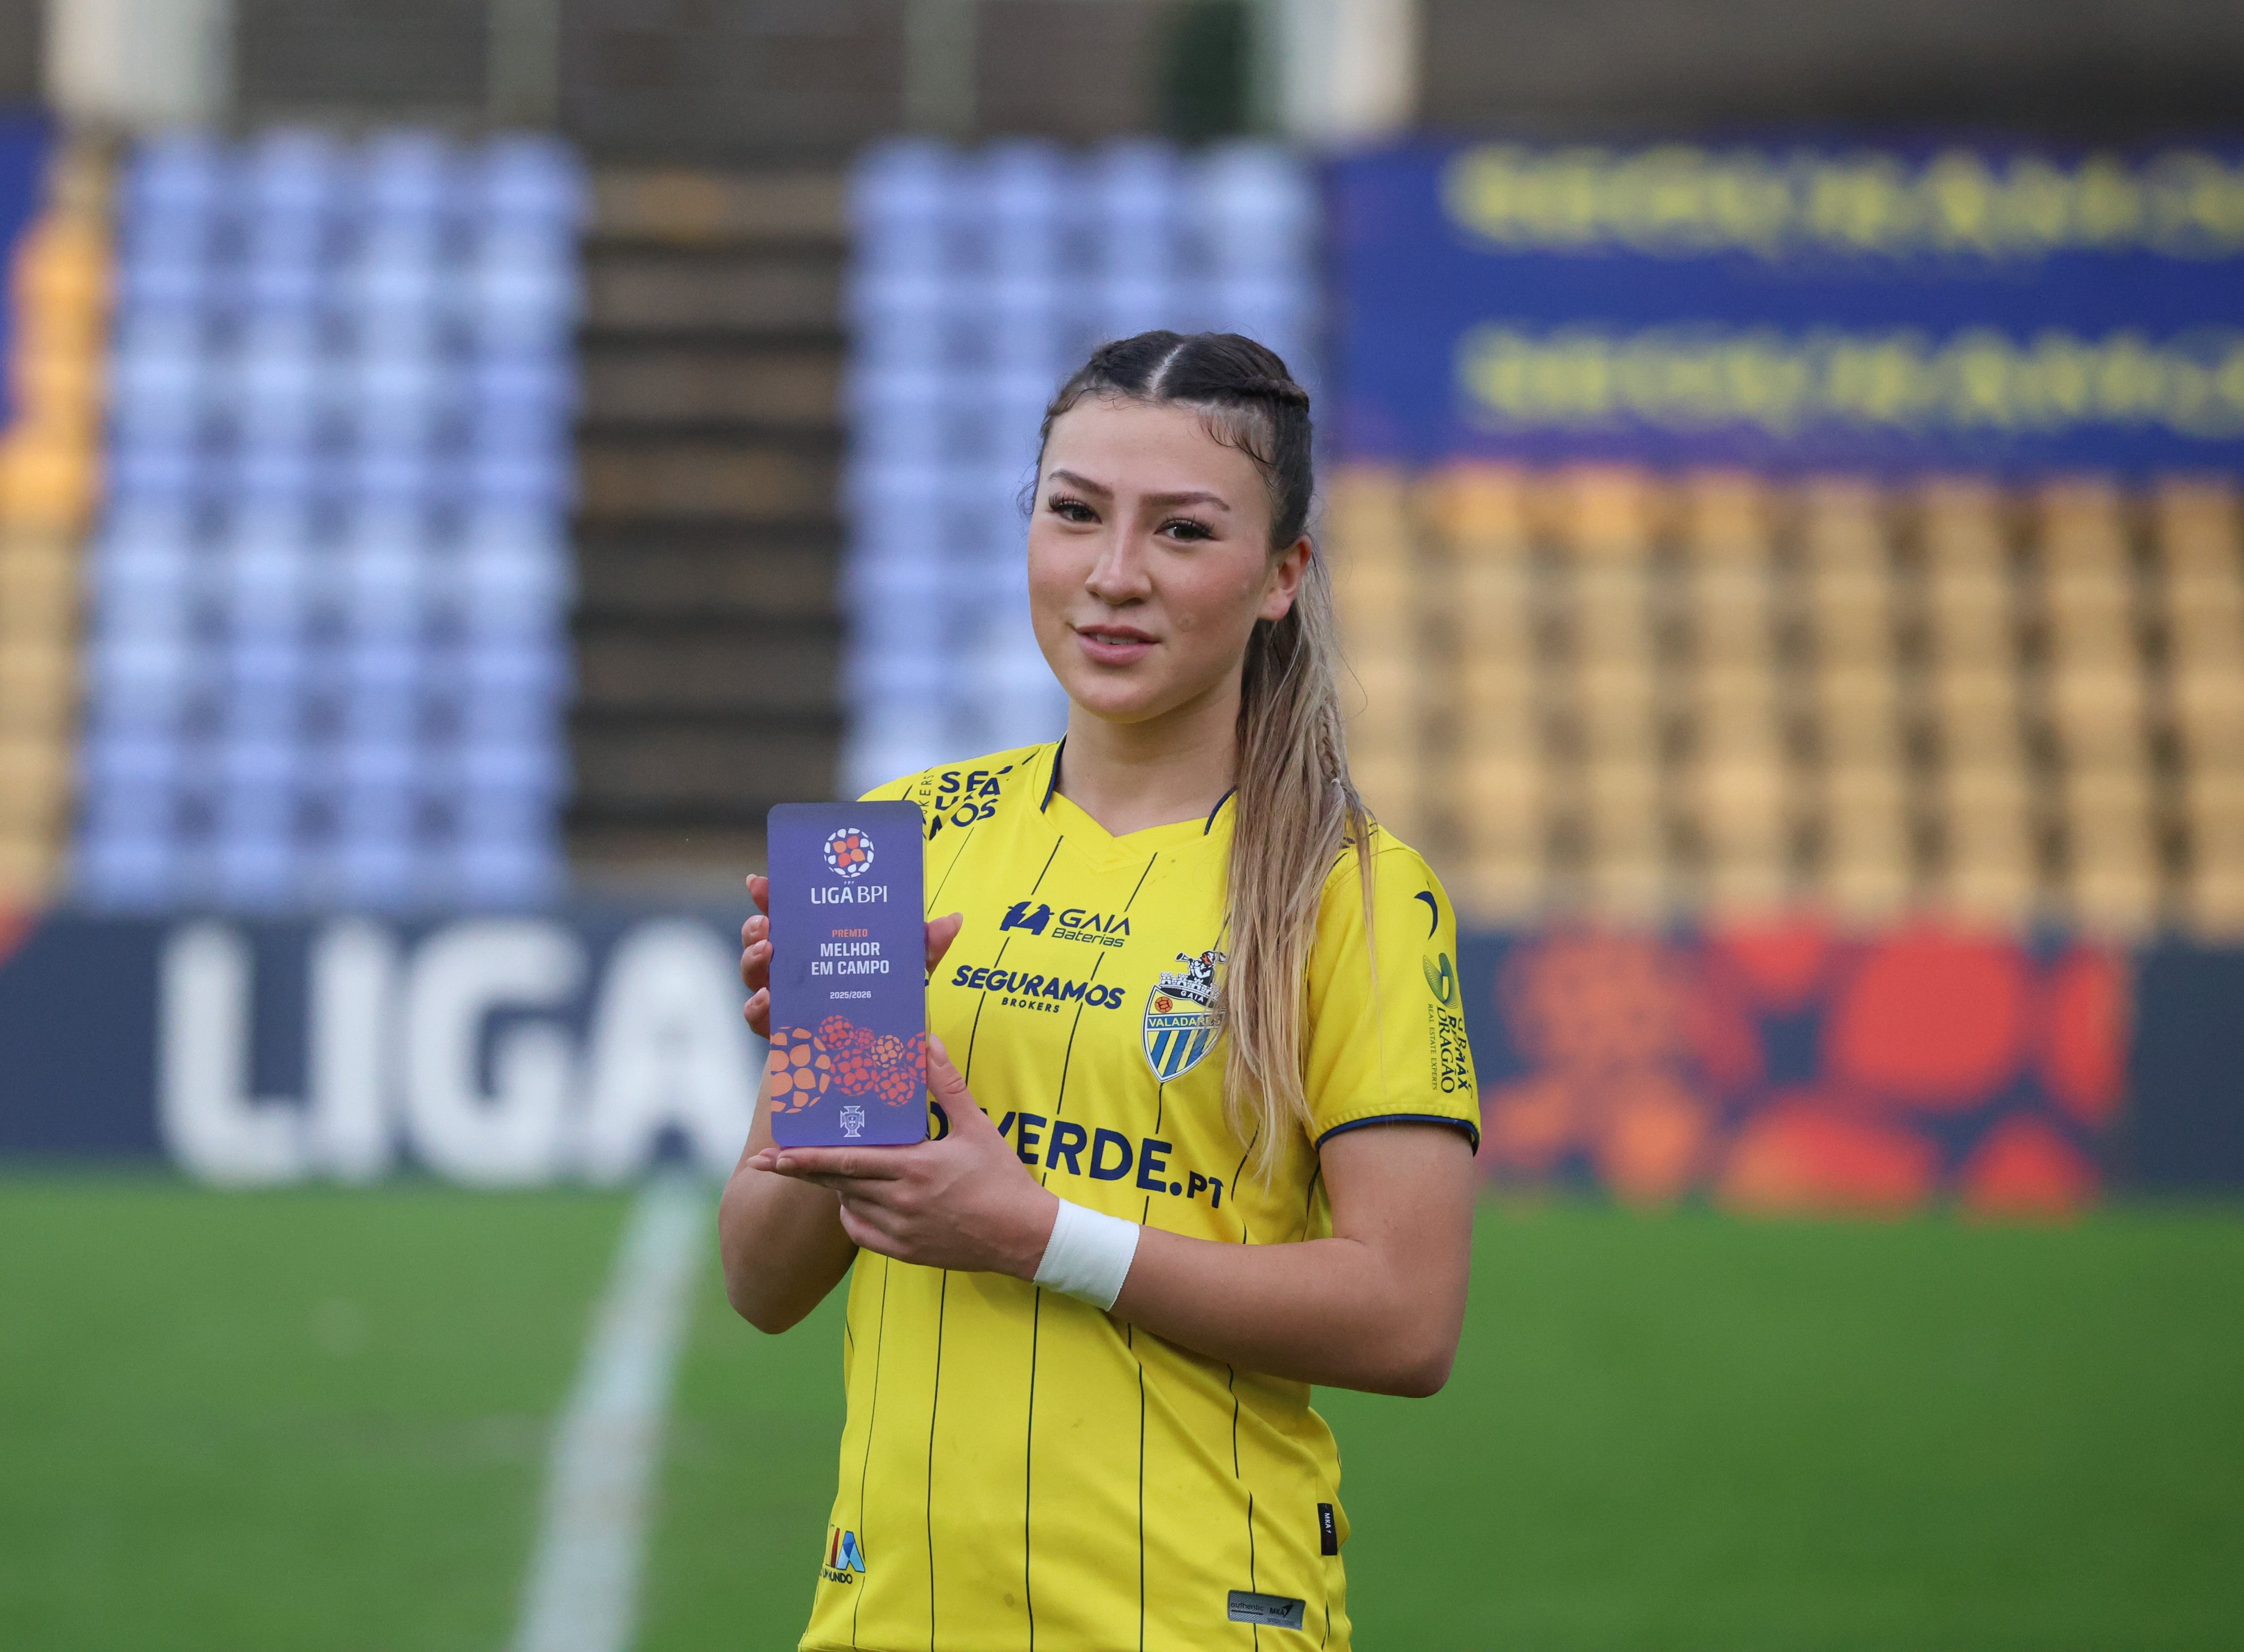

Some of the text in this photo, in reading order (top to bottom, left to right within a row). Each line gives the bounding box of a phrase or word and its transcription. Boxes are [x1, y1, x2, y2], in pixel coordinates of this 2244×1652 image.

[811, 885, 887, 904] LIGA BPI
[1059, 908, 1131, 936] GAIA
[1051, 927, 1125, 948] Baterias
[820, 942, 880, 957] MELHOR
[811, 960, 889, 975] EM CAMPO
[830, 990, 872, 999] 2025/2026
[952, 965, 1125, 1010] SEGURAMOS
[1180, 990, 1203, 1003] GAIA
[1002, 997, 1060, 1014] BROKERS
[160, 917, 758, 1187] LIGA
[1437, 1005, 1457, 1094] DRAGÃO
